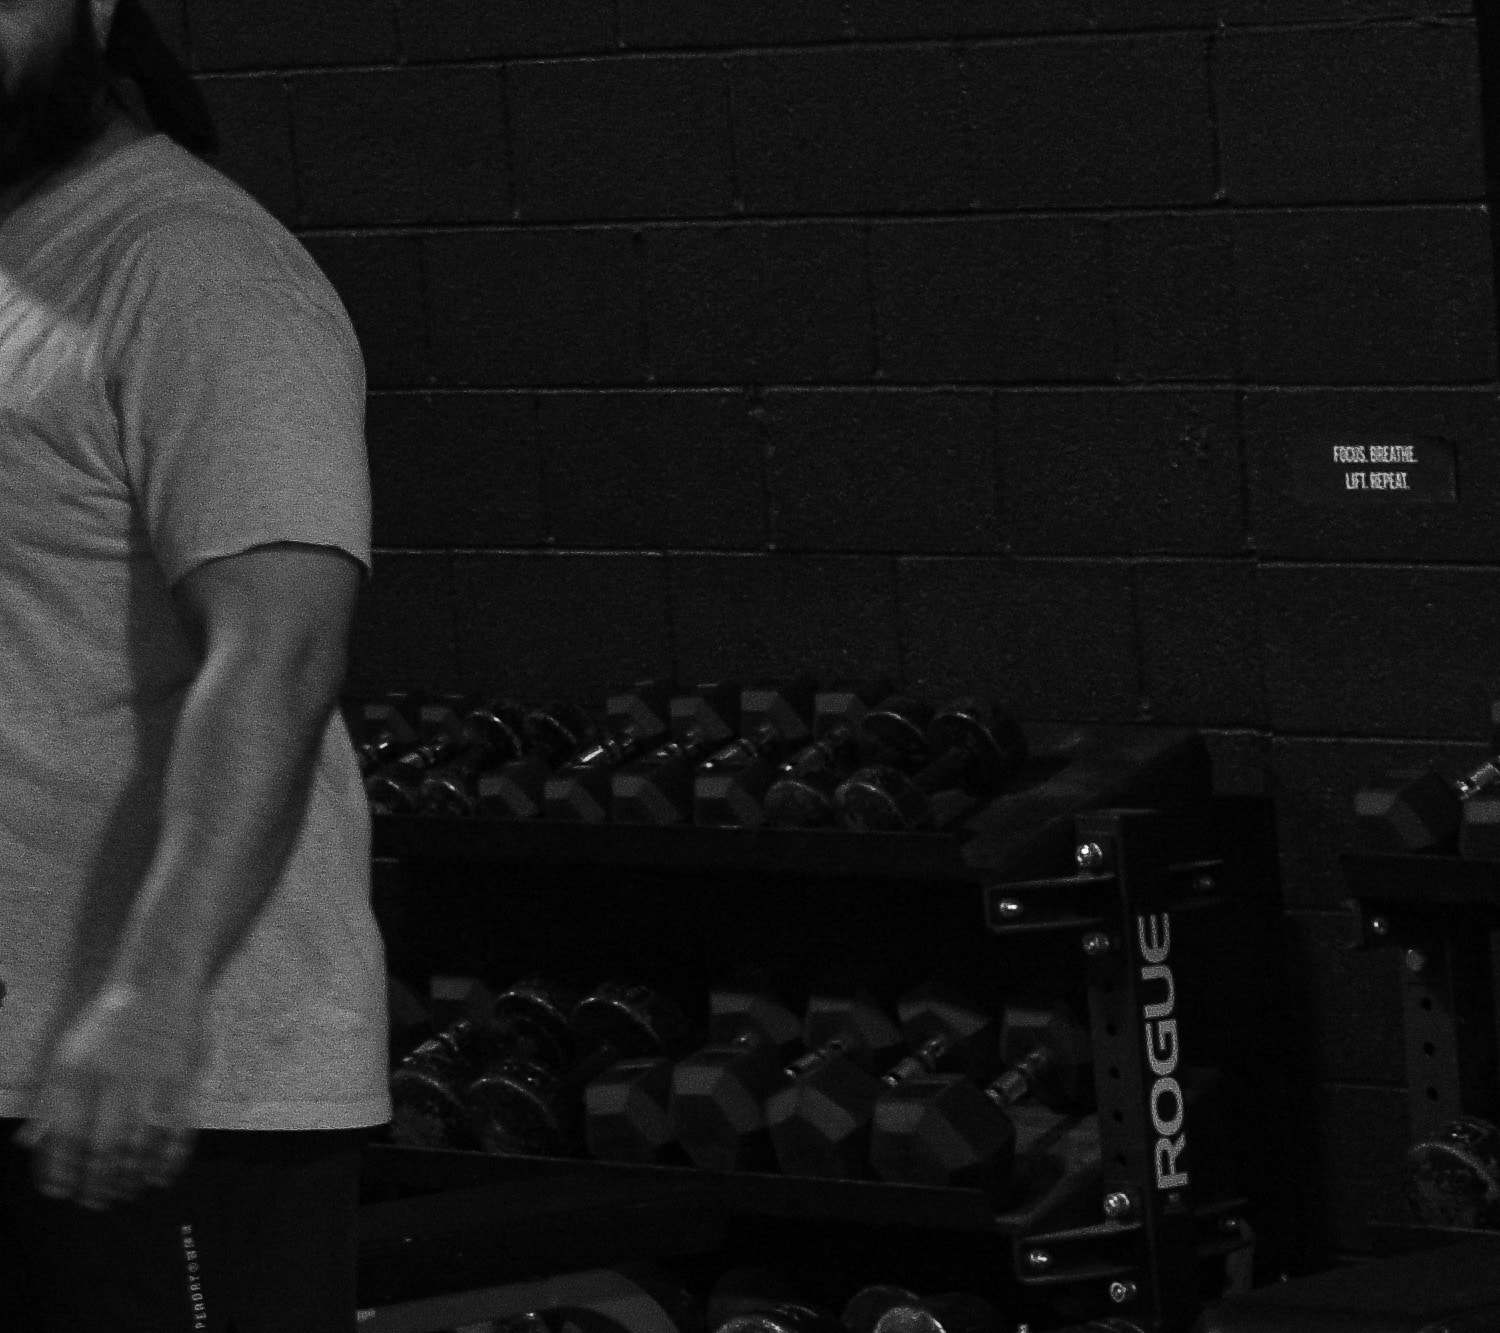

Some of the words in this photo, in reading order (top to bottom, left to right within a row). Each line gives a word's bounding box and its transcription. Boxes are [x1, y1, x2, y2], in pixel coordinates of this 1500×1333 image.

[1333, 445, 1369, 463] FOCUS.
[1369, 445, 1418, 463] BREATHE.
[1345, 472, 1369, 490] LIFT.
[1369, 472, 1410, 490] REPEAT.
[1138, 913, 1188, 1189] ROGUE
